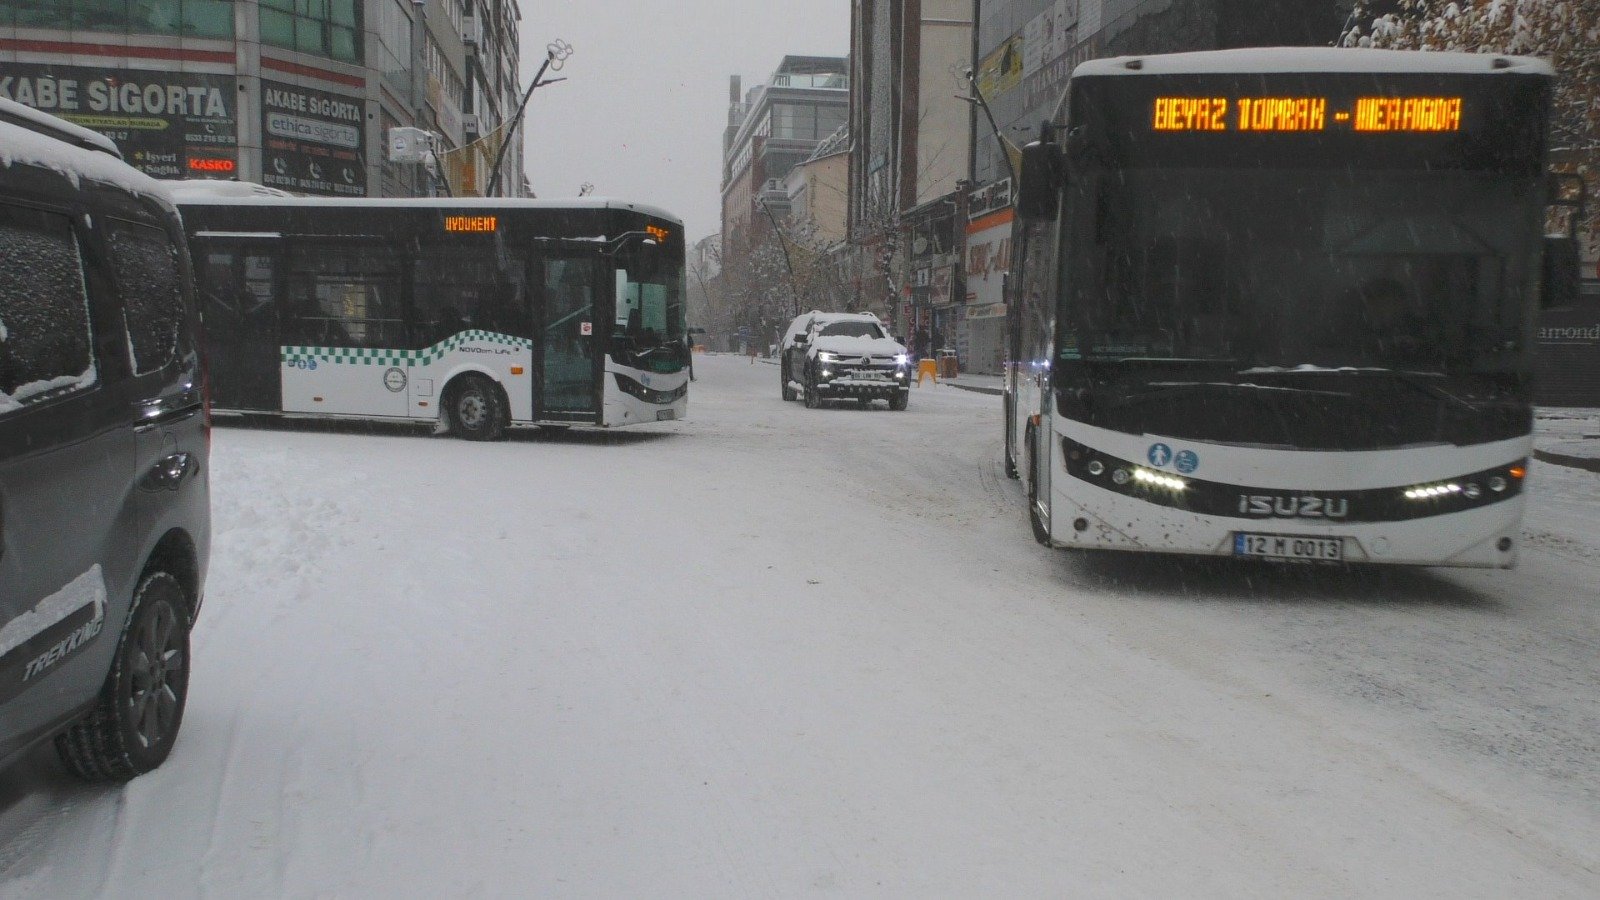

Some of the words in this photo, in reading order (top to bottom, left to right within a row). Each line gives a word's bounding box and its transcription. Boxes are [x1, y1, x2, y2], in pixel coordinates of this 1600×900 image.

[265, 88, 306, 112] AKABE
[189, 158, 234, 171] KASKO
[1238, 494, 1348, 517] ISUZU
[1247, 537, 1267, 554] 12
[1293, 539, 1339, 558] 0013
[23, 619, 103, 682] TREKKING
